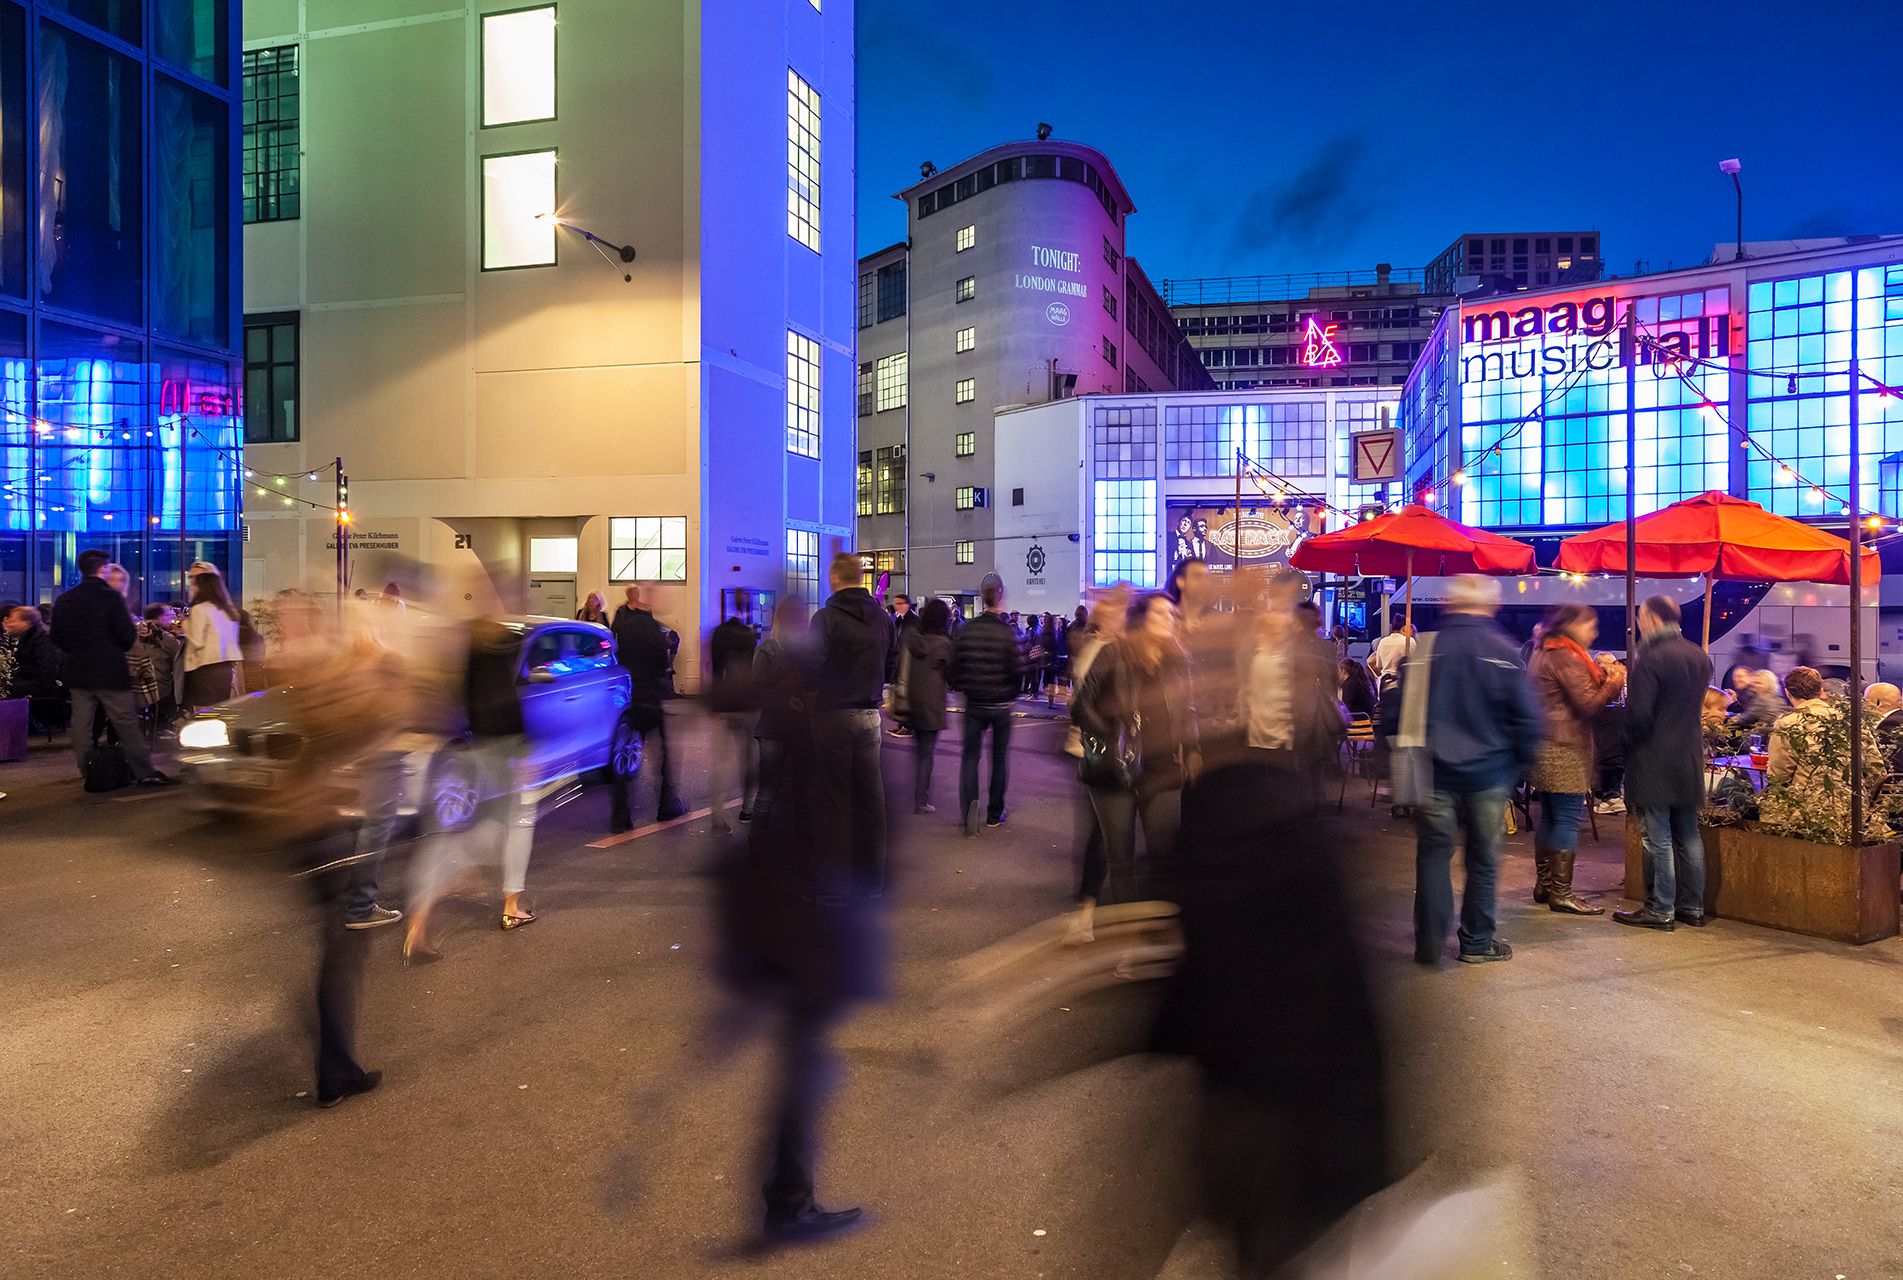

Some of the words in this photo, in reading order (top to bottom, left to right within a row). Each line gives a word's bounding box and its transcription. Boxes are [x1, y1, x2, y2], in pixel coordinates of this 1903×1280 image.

[1031, 245, 1081, 273] TONIGHT:
[1015, 273, 1056, 292] LONDON
[1057, 280, 1088, 298] GRAMMAR
[1464, 295, 1616, 342] maag
[974, 491, 981, 502] K
[455, 534, 471, 549] 21
[1245, 529, 1289, 545] PACK
